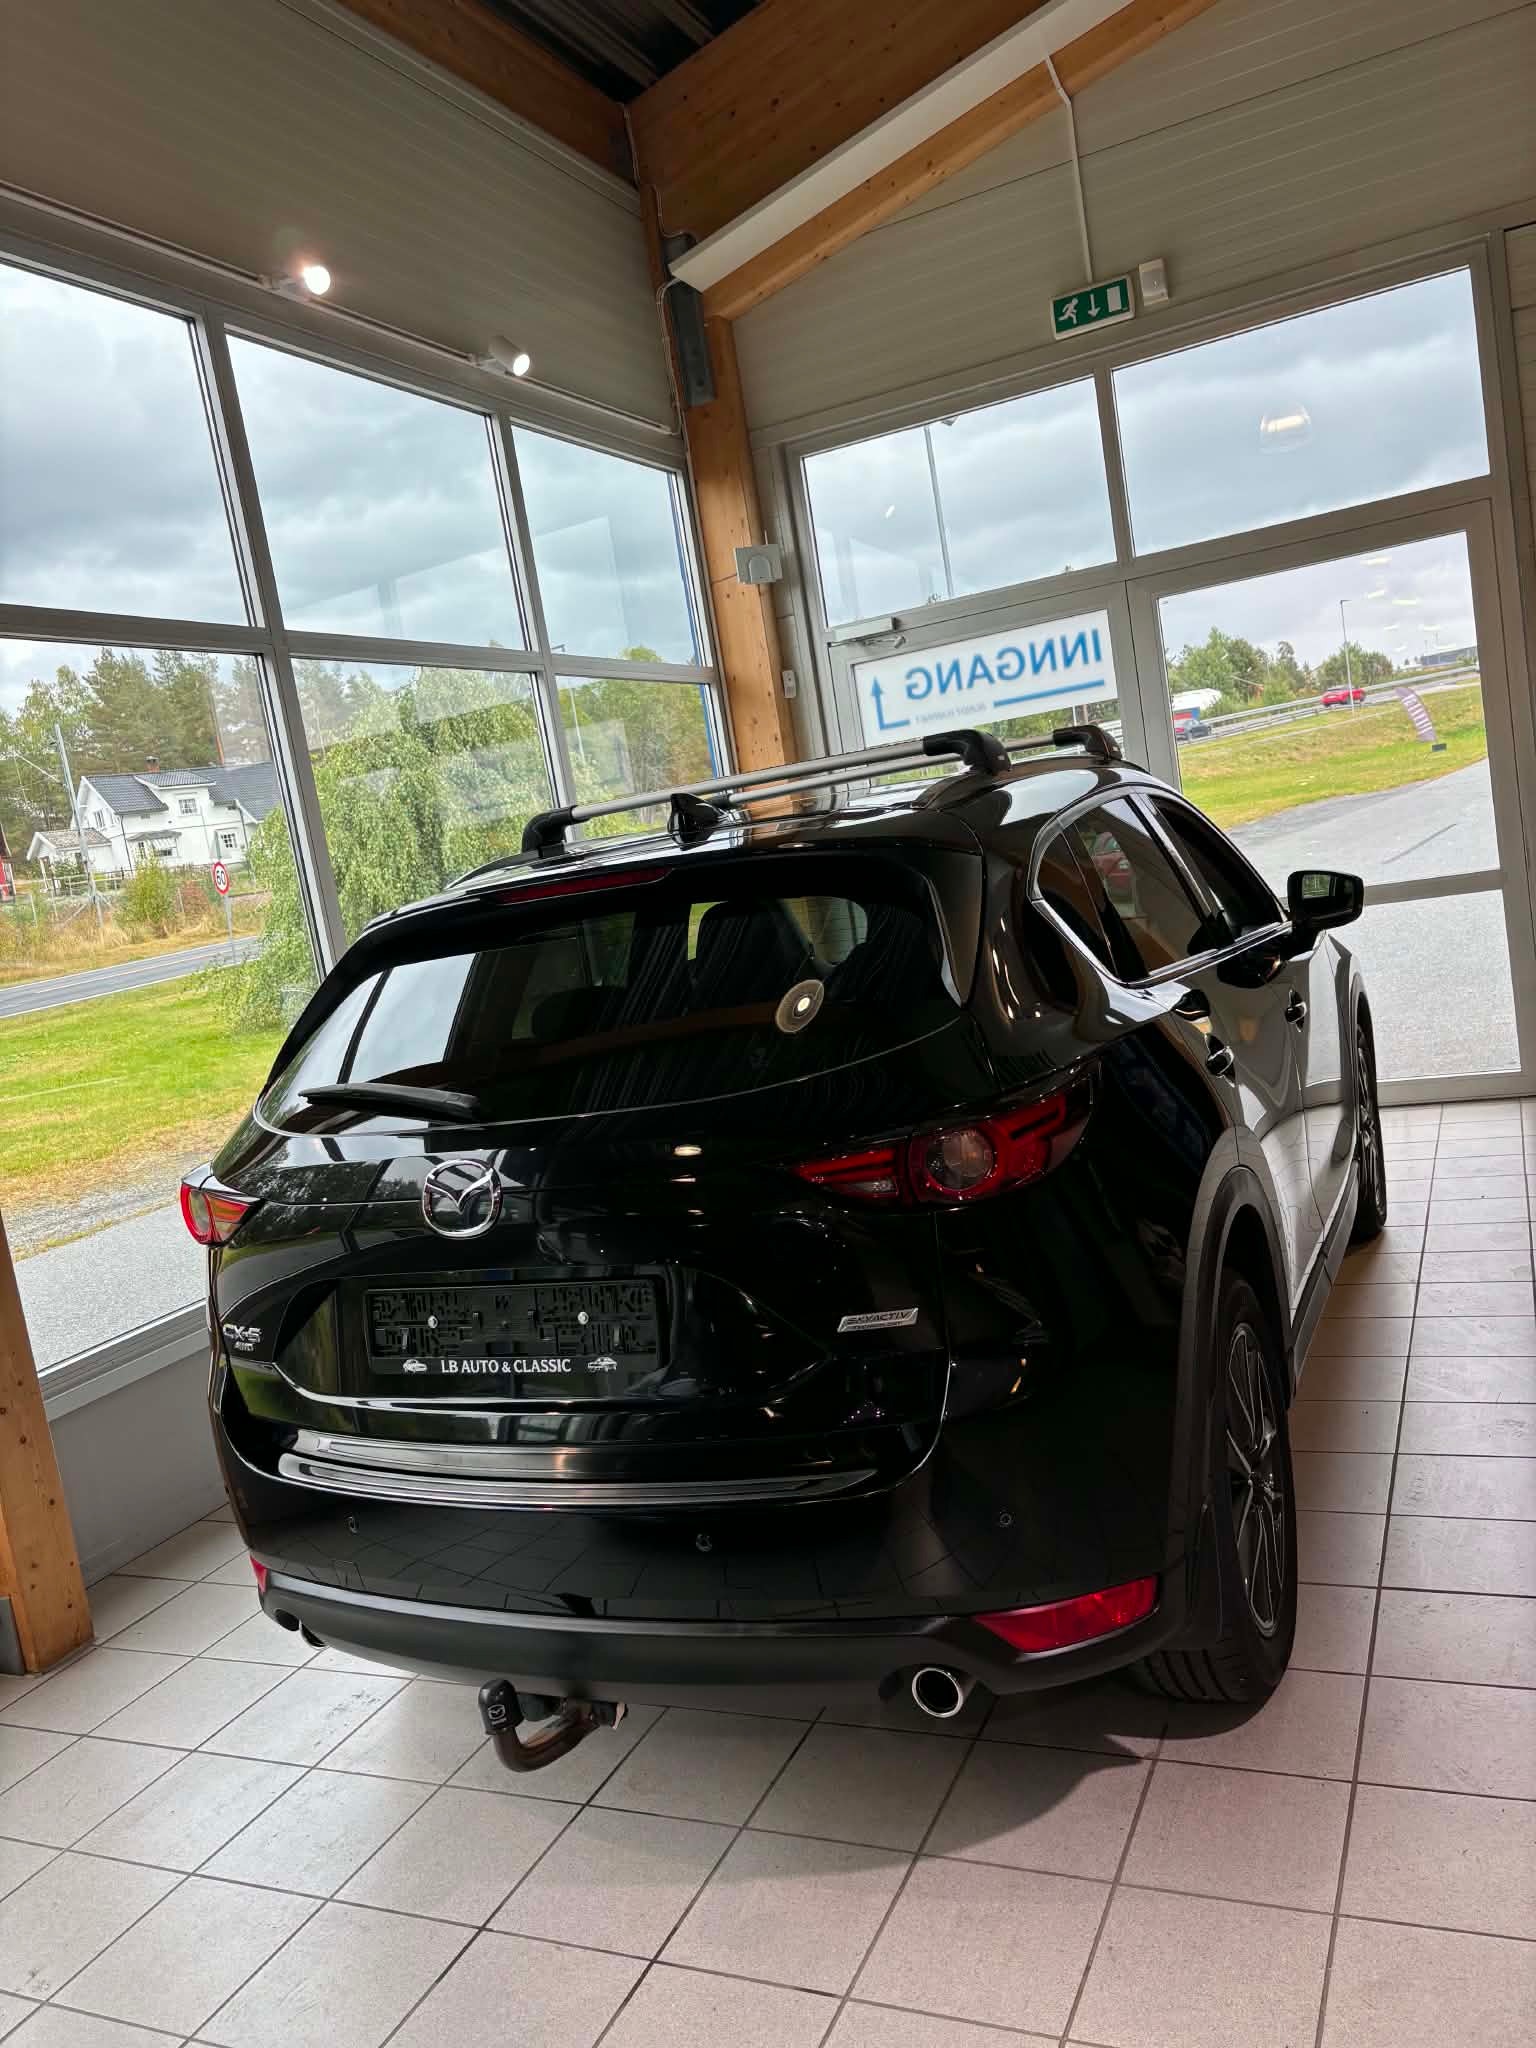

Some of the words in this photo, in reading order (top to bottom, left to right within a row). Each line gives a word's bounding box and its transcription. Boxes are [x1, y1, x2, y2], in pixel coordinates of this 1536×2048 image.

[440, 1359, 459, 1373] LB
[461, 1359, 499, 1373] AUTO
[501, 1361, 512, 1373] &
[513, 1358, 572, 1373] CLASSIC
